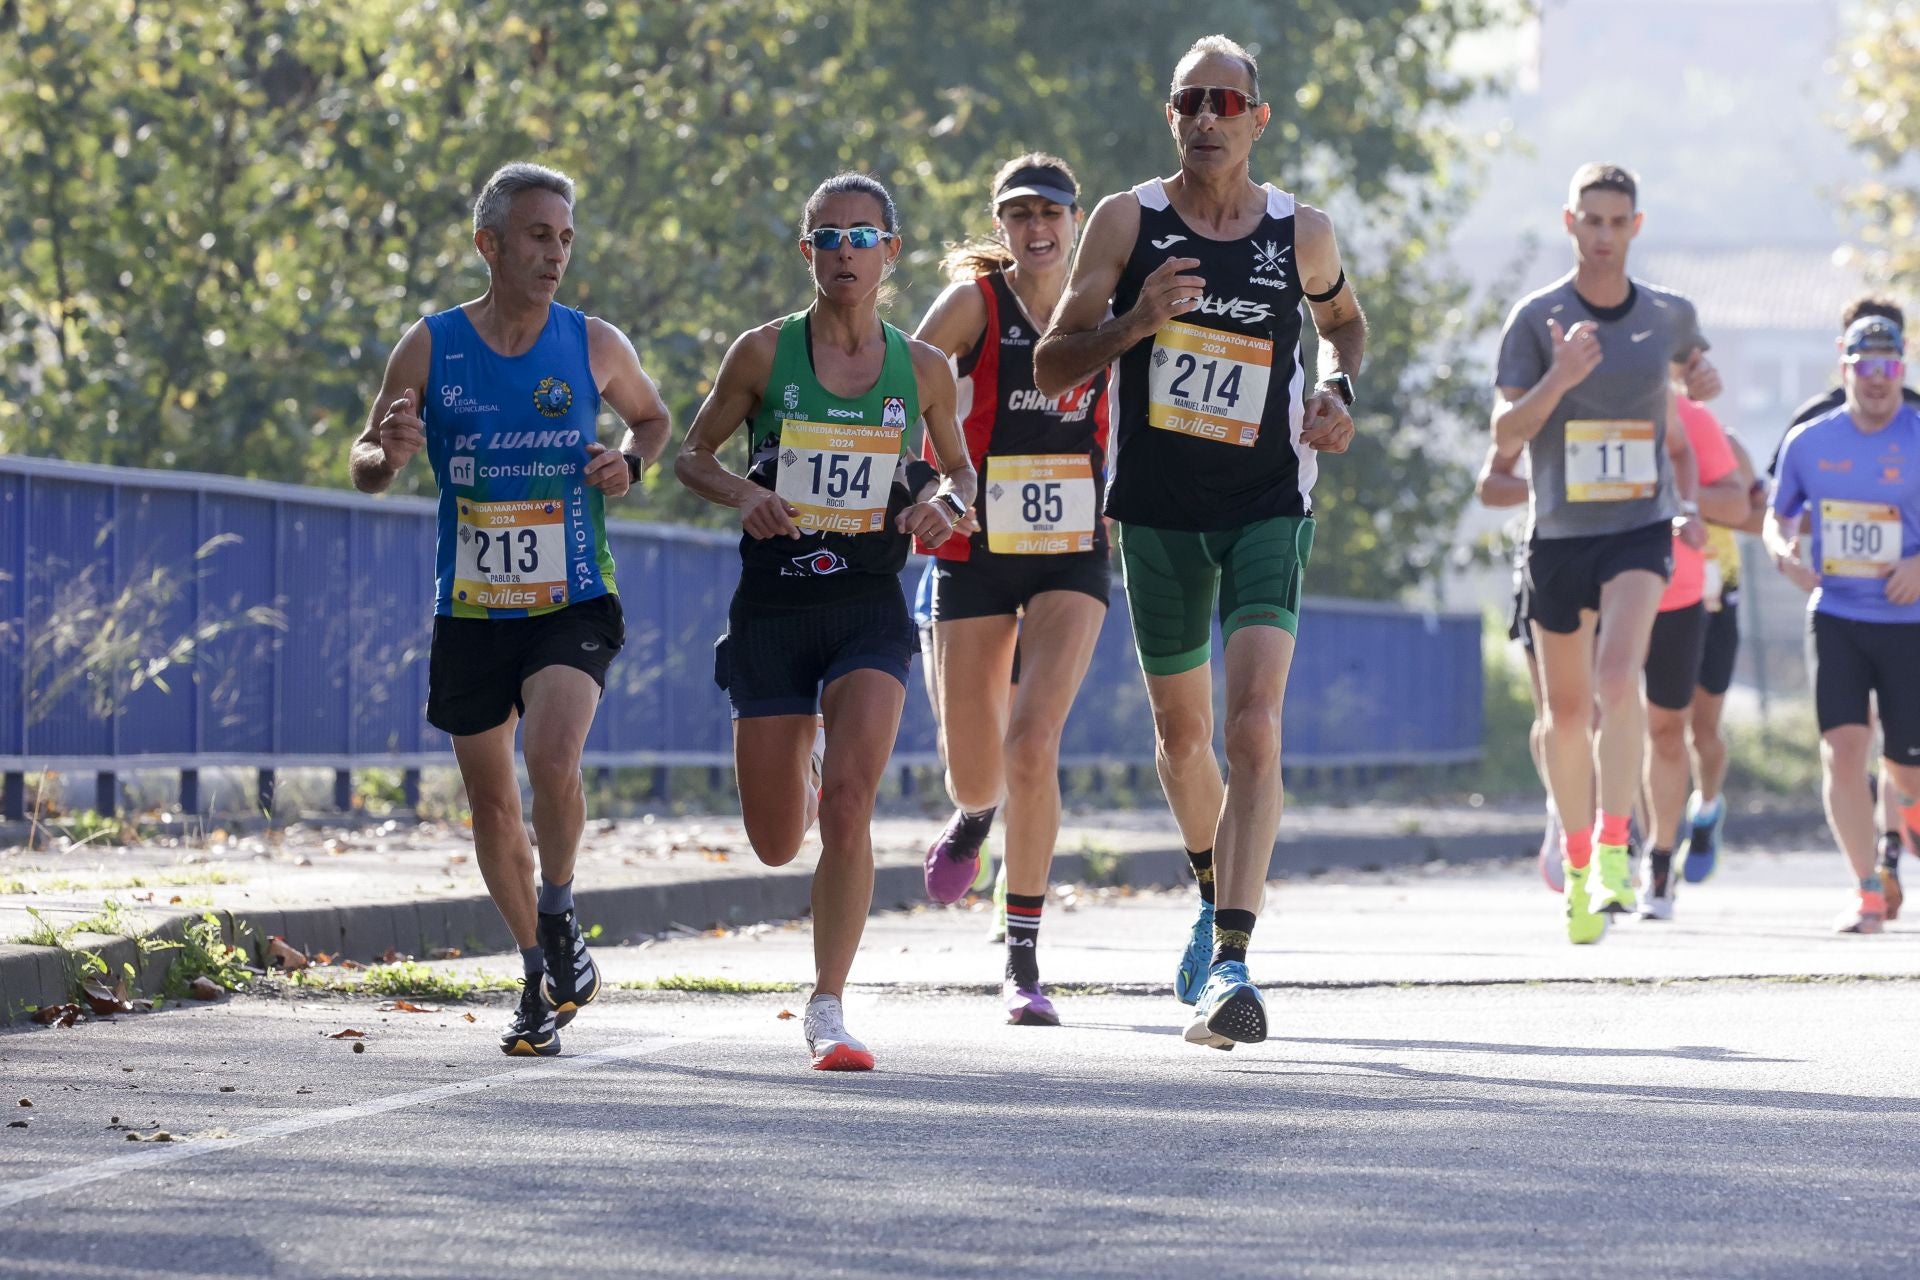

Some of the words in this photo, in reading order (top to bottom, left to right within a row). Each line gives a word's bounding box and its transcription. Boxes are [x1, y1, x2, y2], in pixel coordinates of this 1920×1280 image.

[1250, 276, 1288, 290] WOLVES
[1172, 293, 1276, 324] OLVES
[1183, 327, 1207, 338] MEDIA
[1208, 332, 1248, 347] MARATÓN
[1248, 342, 1271, 351] AVILÉS
[1201, 343, 1226, 354] 2024
[1169, 353, 1243, 407] 214
[454, 404, 500, 413] CONCURSAL
[786, 411, 794, 419] de
[1174, 398, 1200, 411] MANUEL
[1201, 404, 1228, 417] ANTONIO
[455, 433, 481, 451] DC
[488, 430, 580, 450] LUANCO
[834, 428, 873, 437] MARATÓN
[874, 430, 899, 438] AVILÉS
[829, 438, 854, 448] 2024
[1597, 444, 1625, 473] 11
[453, 463, 471, 479] nf
[480, 461, 576, 478] consultores
[808, 453, 872, 499] 154
[494, 502, 533, 513] MARATÓN
[1022, 483, 1063, 523] 85
[490, 515, 516, 525] 2024
[572, 486, 587, 554] HOTELS
[1839, 523, 1882, 554] 190
[474, 528, 539, 574] 213
[490, 574, 510, 583] PABLO
[511, 574, 521, 583] 26
[477, 588, 537, 605] avilés
